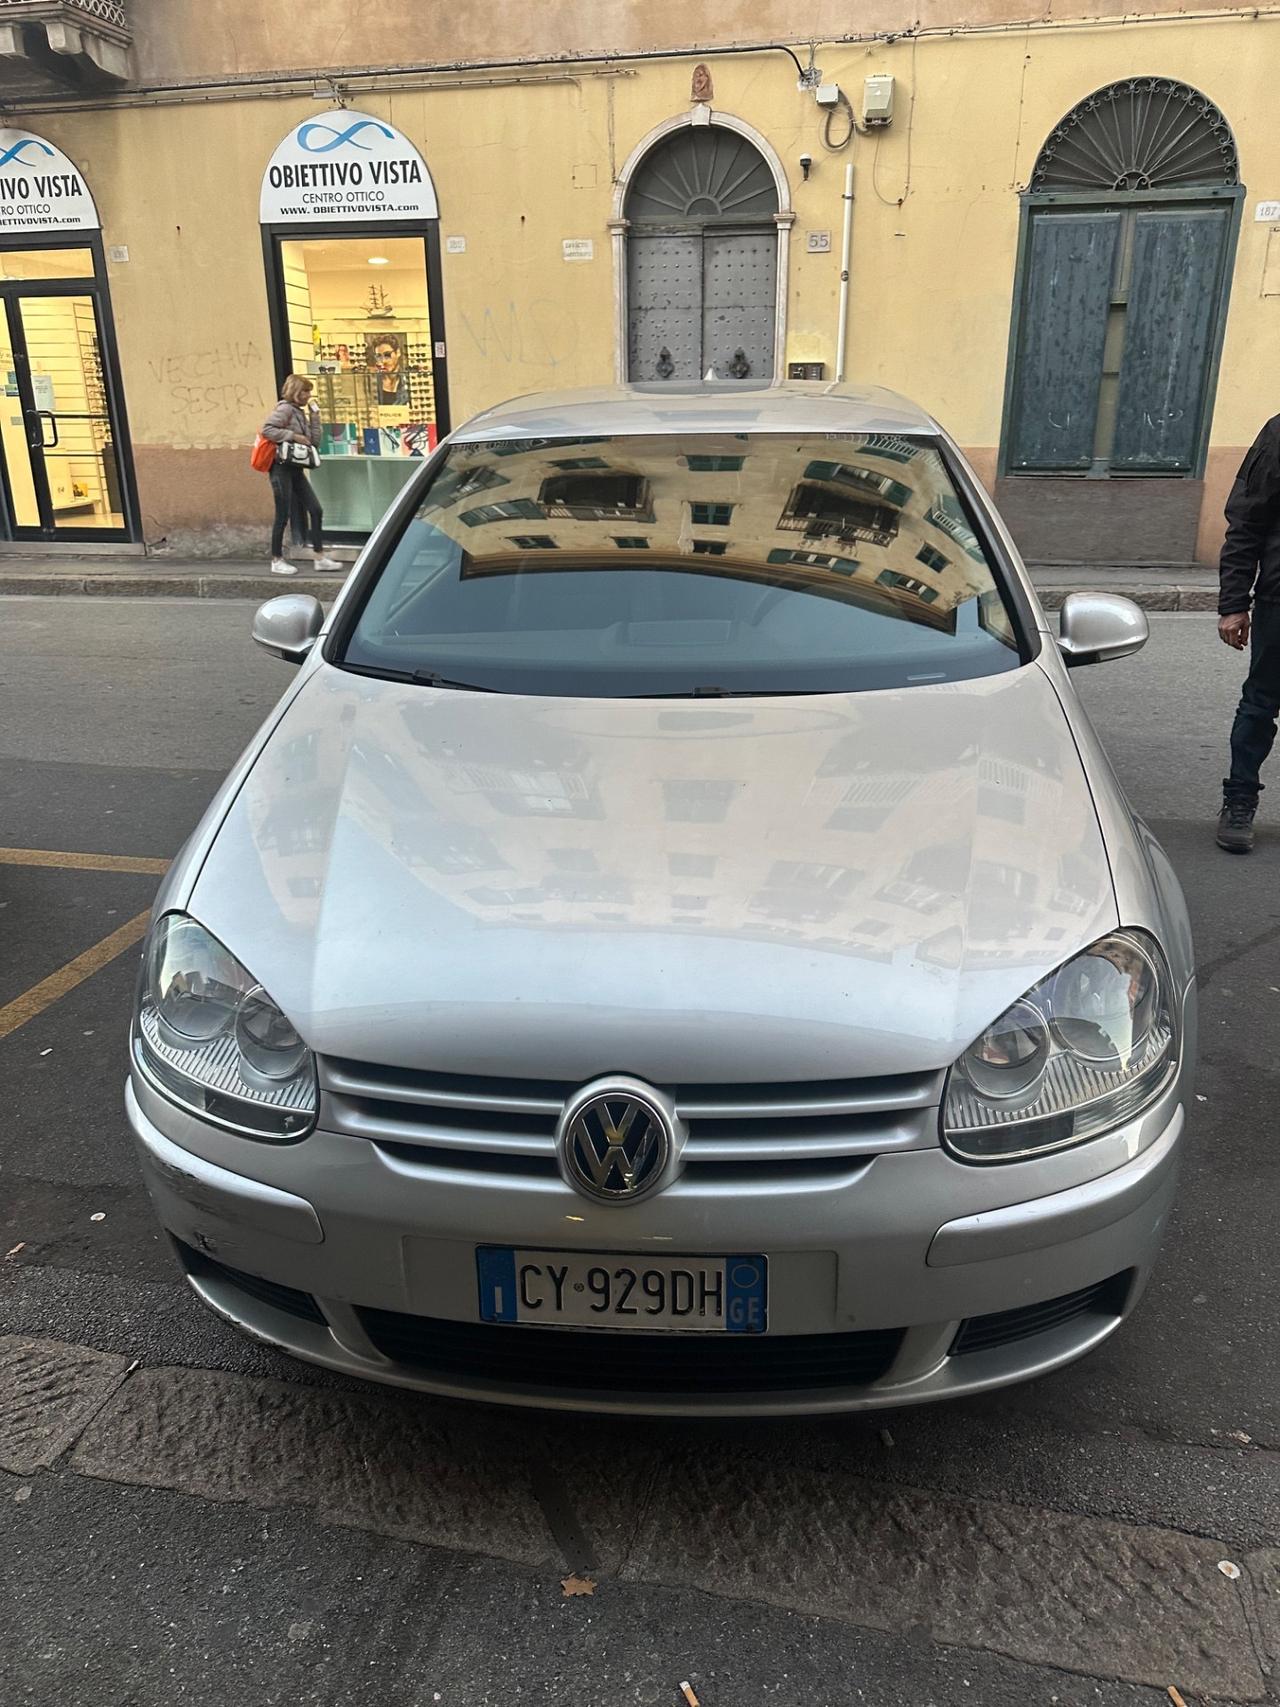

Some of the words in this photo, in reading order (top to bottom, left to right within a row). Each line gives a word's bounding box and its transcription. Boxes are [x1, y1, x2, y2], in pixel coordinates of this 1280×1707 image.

[34, 174, 82, 198] VISTA
[269, 162, 363, 189] OBIETTIVO
[368, 160, 422, 185] VISTA
[17, 203, 51, 215] OTTICO
[302, 192, 343, 204] CENTRO
[346, 190, 385, 202] OTTICO
[809, 234, 828, 248] 55
[148, 341, 262, 383] VECCHIA
[170, 384, 265, 415] SESTRI
[519, 1263, 569, 1311] CY
[587, 1266, 723, 1317] 929DH
[729, 1296, 760, 1324] GE
